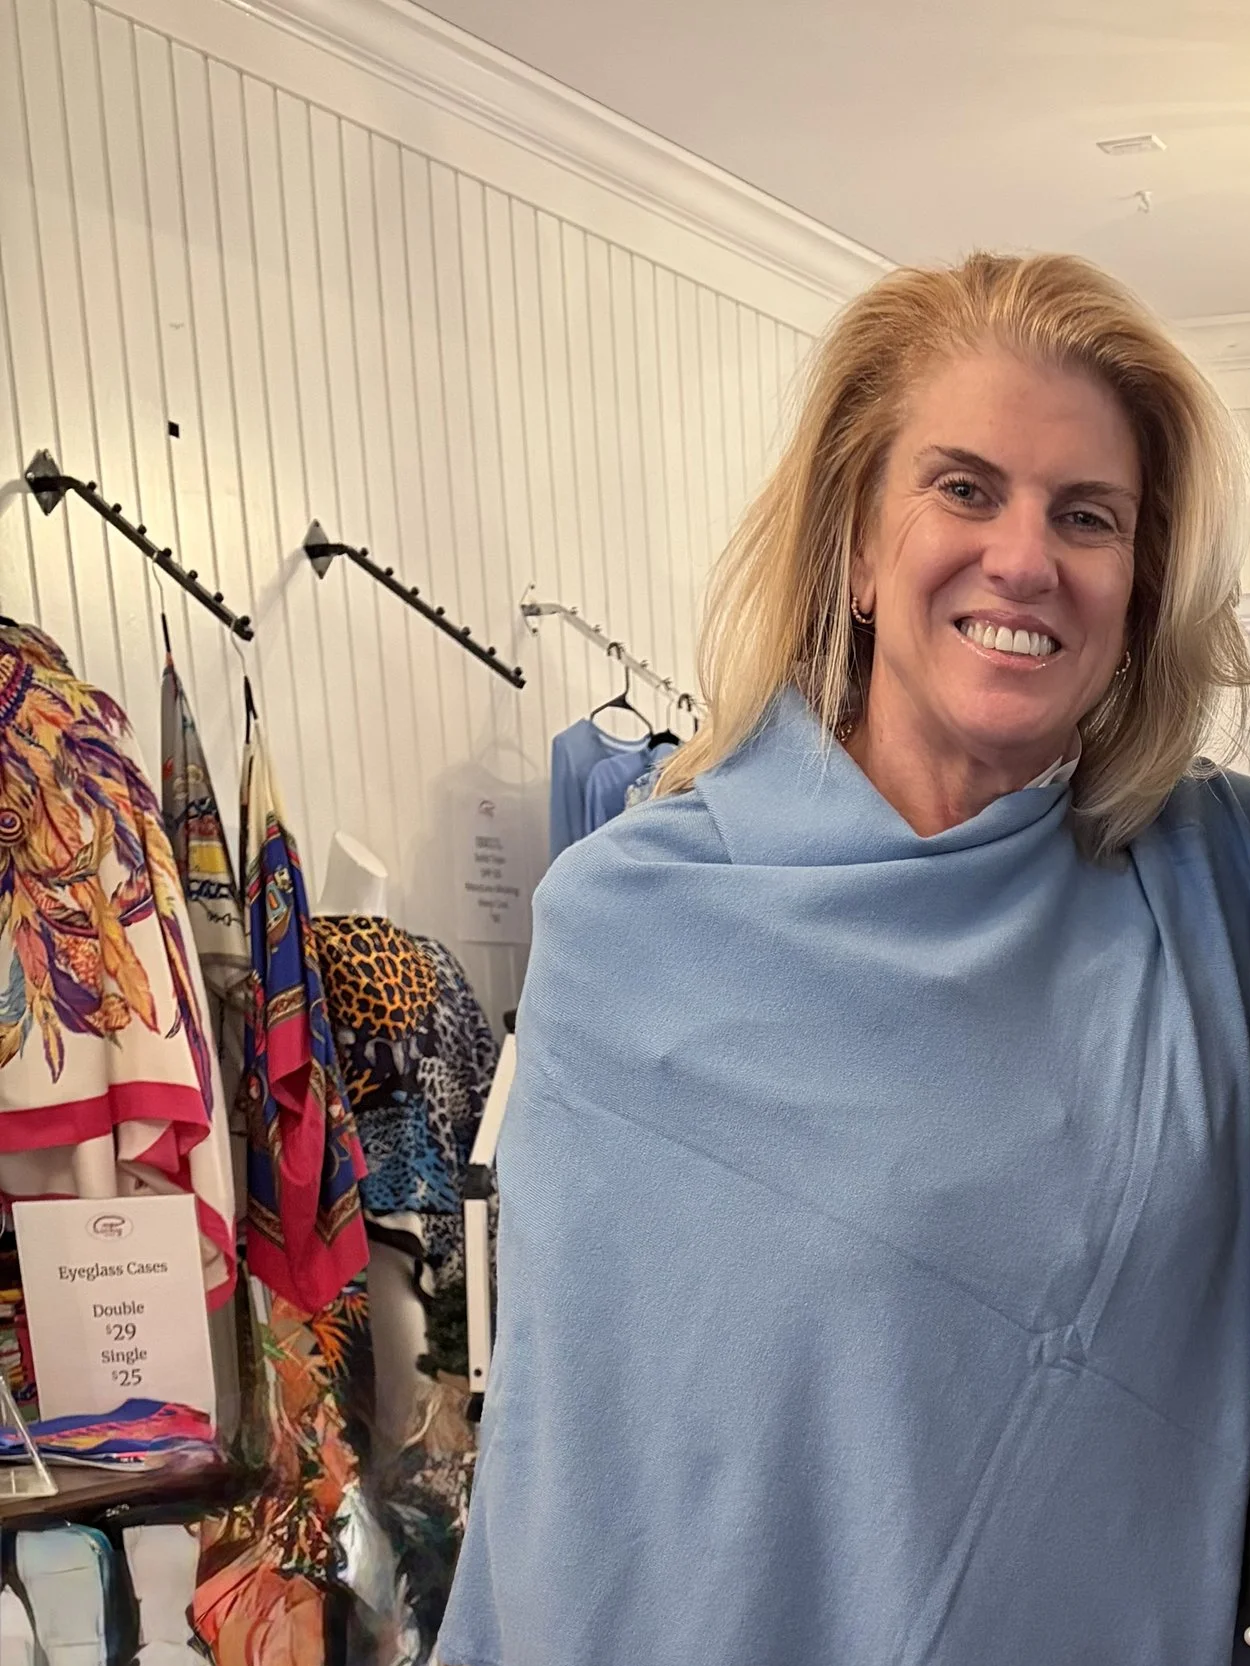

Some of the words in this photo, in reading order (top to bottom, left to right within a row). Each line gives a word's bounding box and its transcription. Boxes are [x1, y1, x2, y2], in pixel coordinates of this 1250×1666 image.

[58, 1262, 124, 1282] Eyeglass
[126, 1261, 168, 1275] Cases
[93, 1300, 145, 1318] Double
[105, 1322, 137, 1341] $29
[101, 1345, 147, 1365] Single
[111, 1368, 142, 1387] $25
